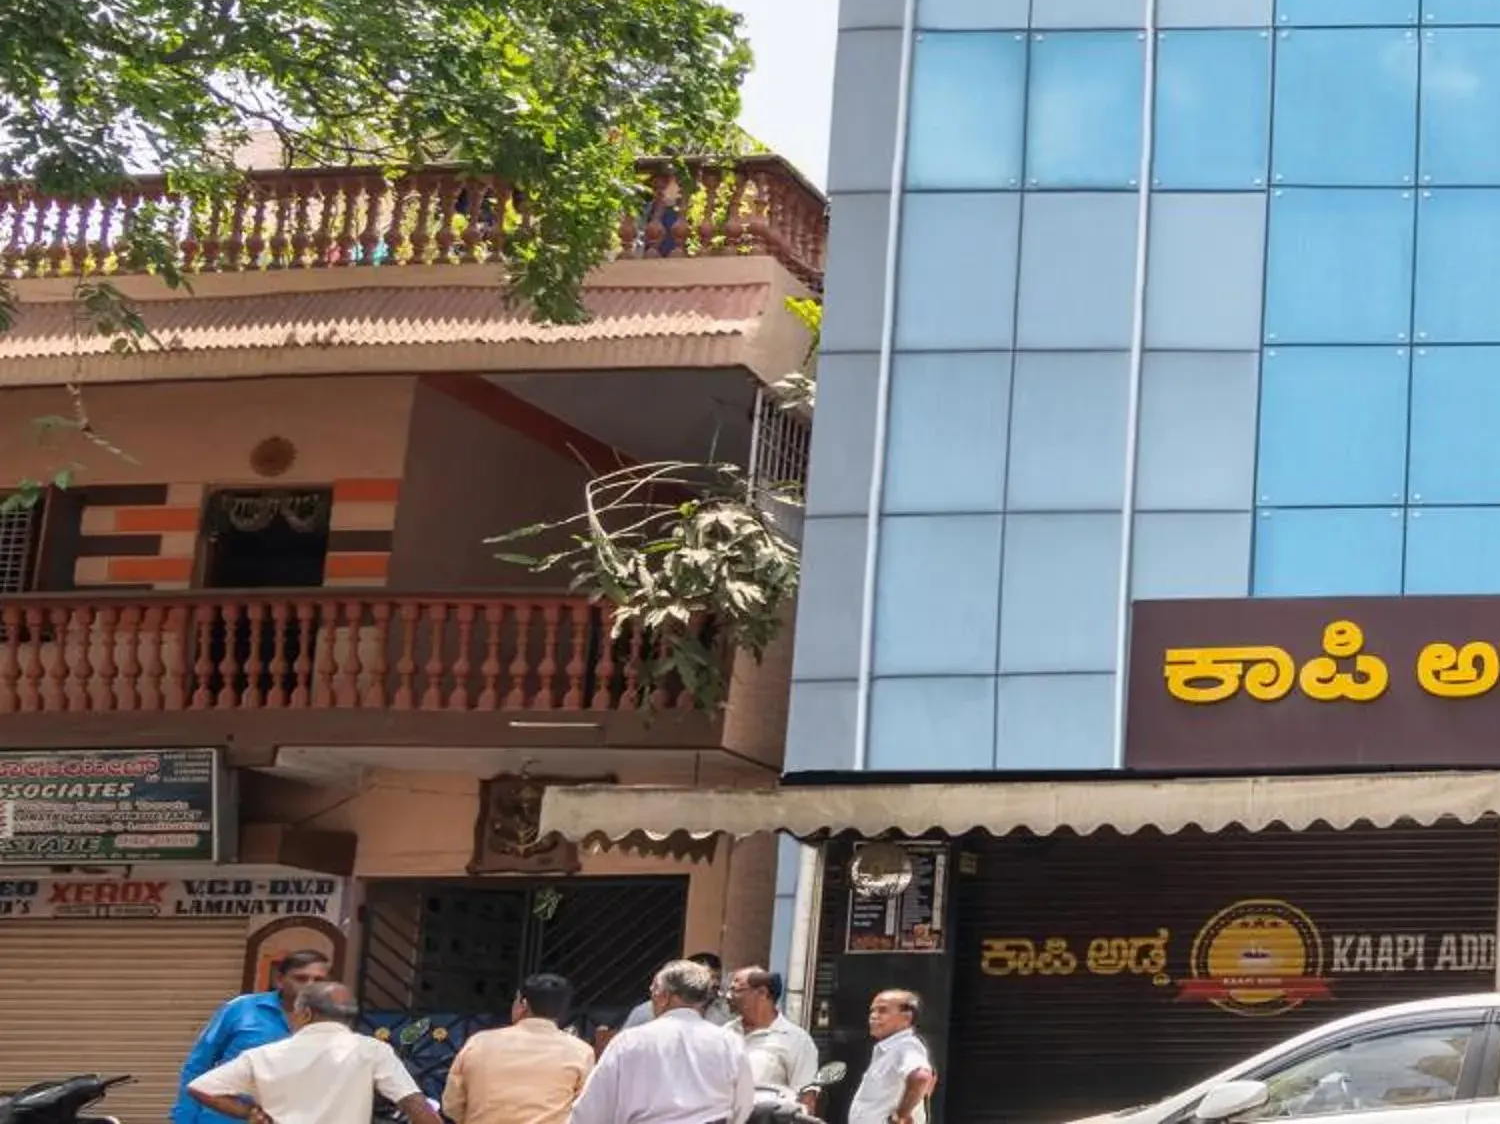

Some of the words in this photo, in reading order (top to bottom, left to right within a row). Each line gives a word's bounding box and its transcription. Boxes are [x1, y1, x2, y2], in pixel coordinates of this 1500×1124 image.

[1164, 619, 1389, 704] ಕಾಪಿ
[48, 881, 168, 903] XEROX
[175, 899, 328, 914] LAMINATION
[1331, 933, 1427, 973] KAAPI
